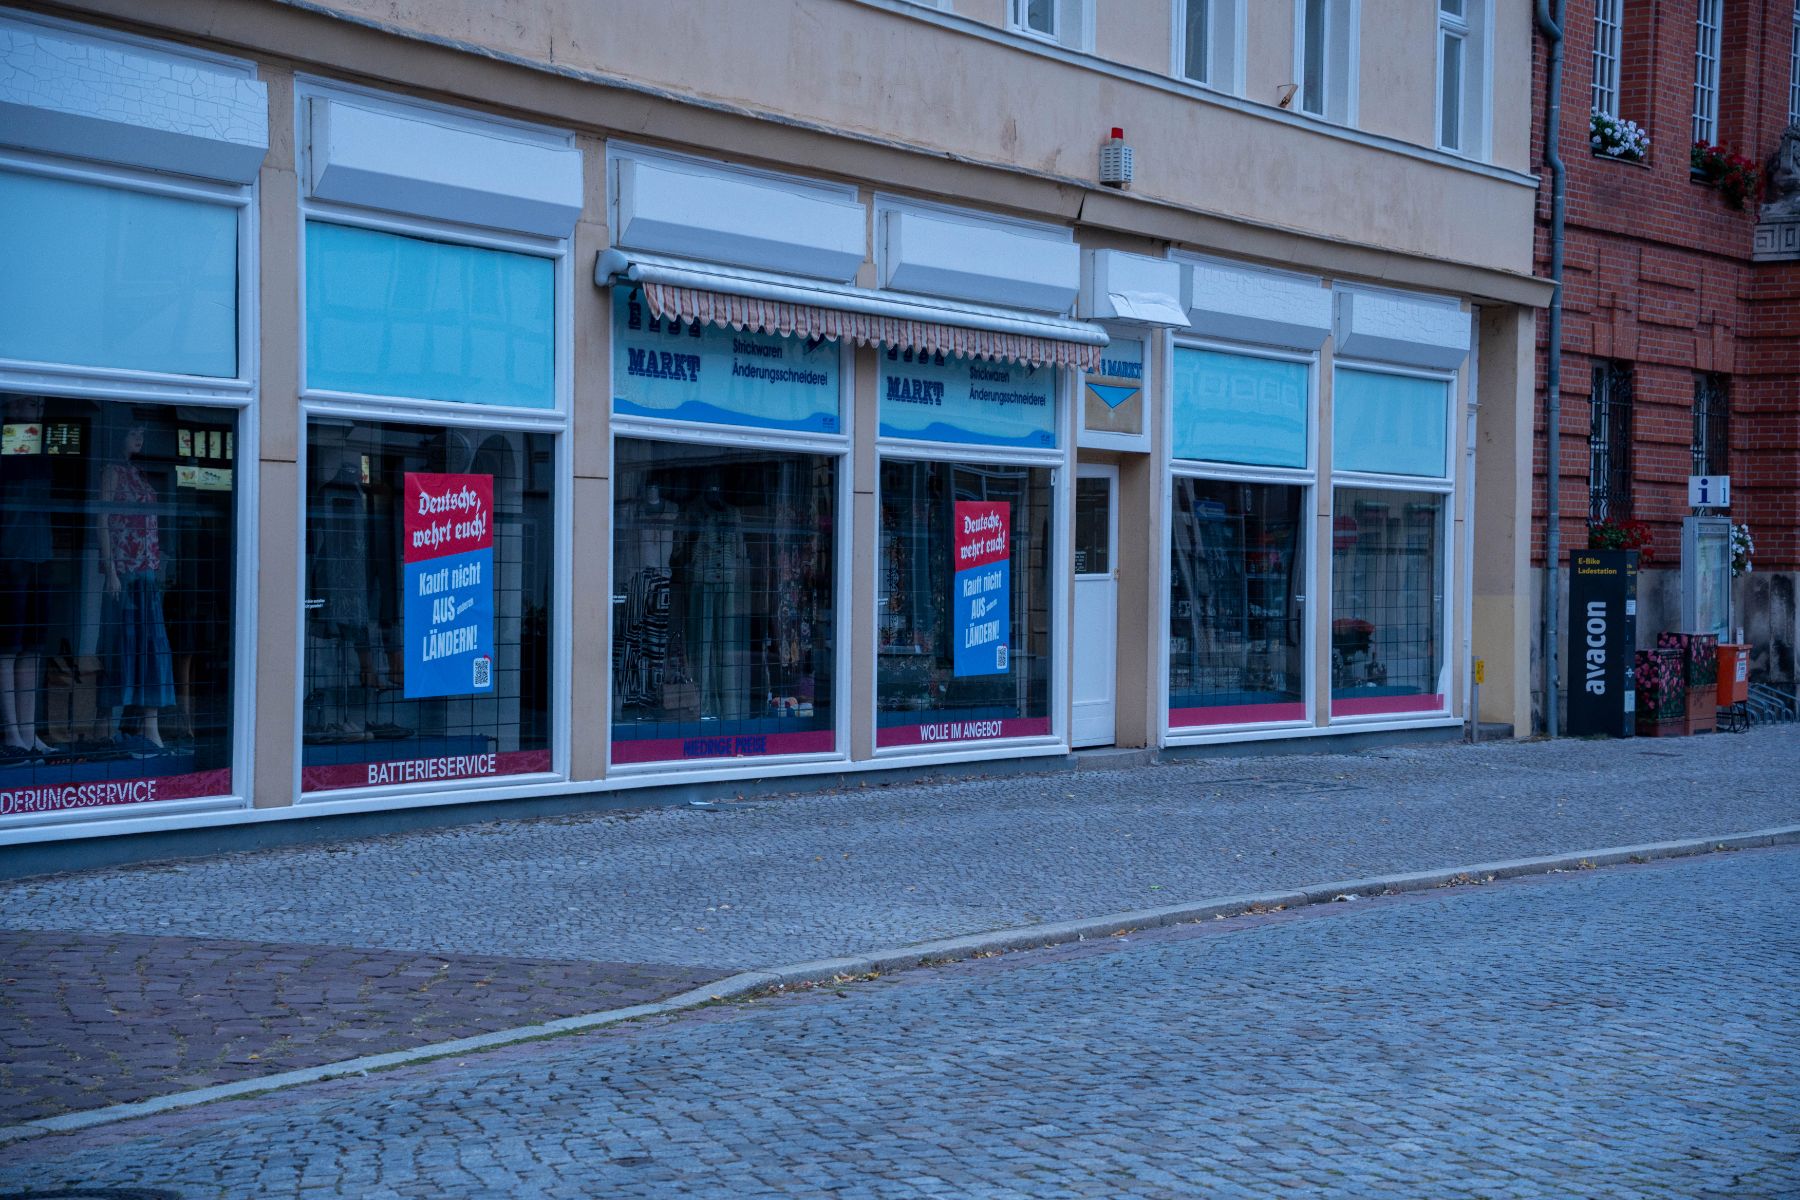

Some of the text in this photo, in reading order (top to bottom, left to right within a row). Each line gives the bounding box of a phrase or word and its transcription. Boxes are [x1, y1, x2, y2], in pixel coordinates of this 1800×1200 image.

[733, 338, 782, 358] Strickwaren
[628, 347, 700, 382] MARKT
[732, 358, 828, 385] Änderungsschneiderei
[970, 366, 1010, 383] Strickwaren
[1108, 360, 1142, 379] MARKT
[886, 376, 944, 406] MARKT
[969, 382, 1046, 406] Änderungsschneiderei
[418, 485, 481, 515] Deutsche,
[412, 510, 486, 550] wehrt euch!
[964, 510, 1002, 534] Deutsche,
[961, 530, 1005, 561] wehrt euch!
[419, 561, 480, 596] Kauft nicht
[963, 570, 1002, 597] Kauft nicht
[1578, 567, 1617, 575] Ladestation
[423, 624, 478, 662] LÄNDERN!
[965, 620, 1000, 648] LÄNDERN!
[1586, 601, 1606, 696] avacon
[920, 721, 1002, 741] WOLLE IM ANGEBOT
[683, 735, 767, 757] NIEDRIGE PREISE
[368, 753, 496, 785] BATTERIESERVICE
[0, 780, 157, 814] DERUNGSSERVICE
